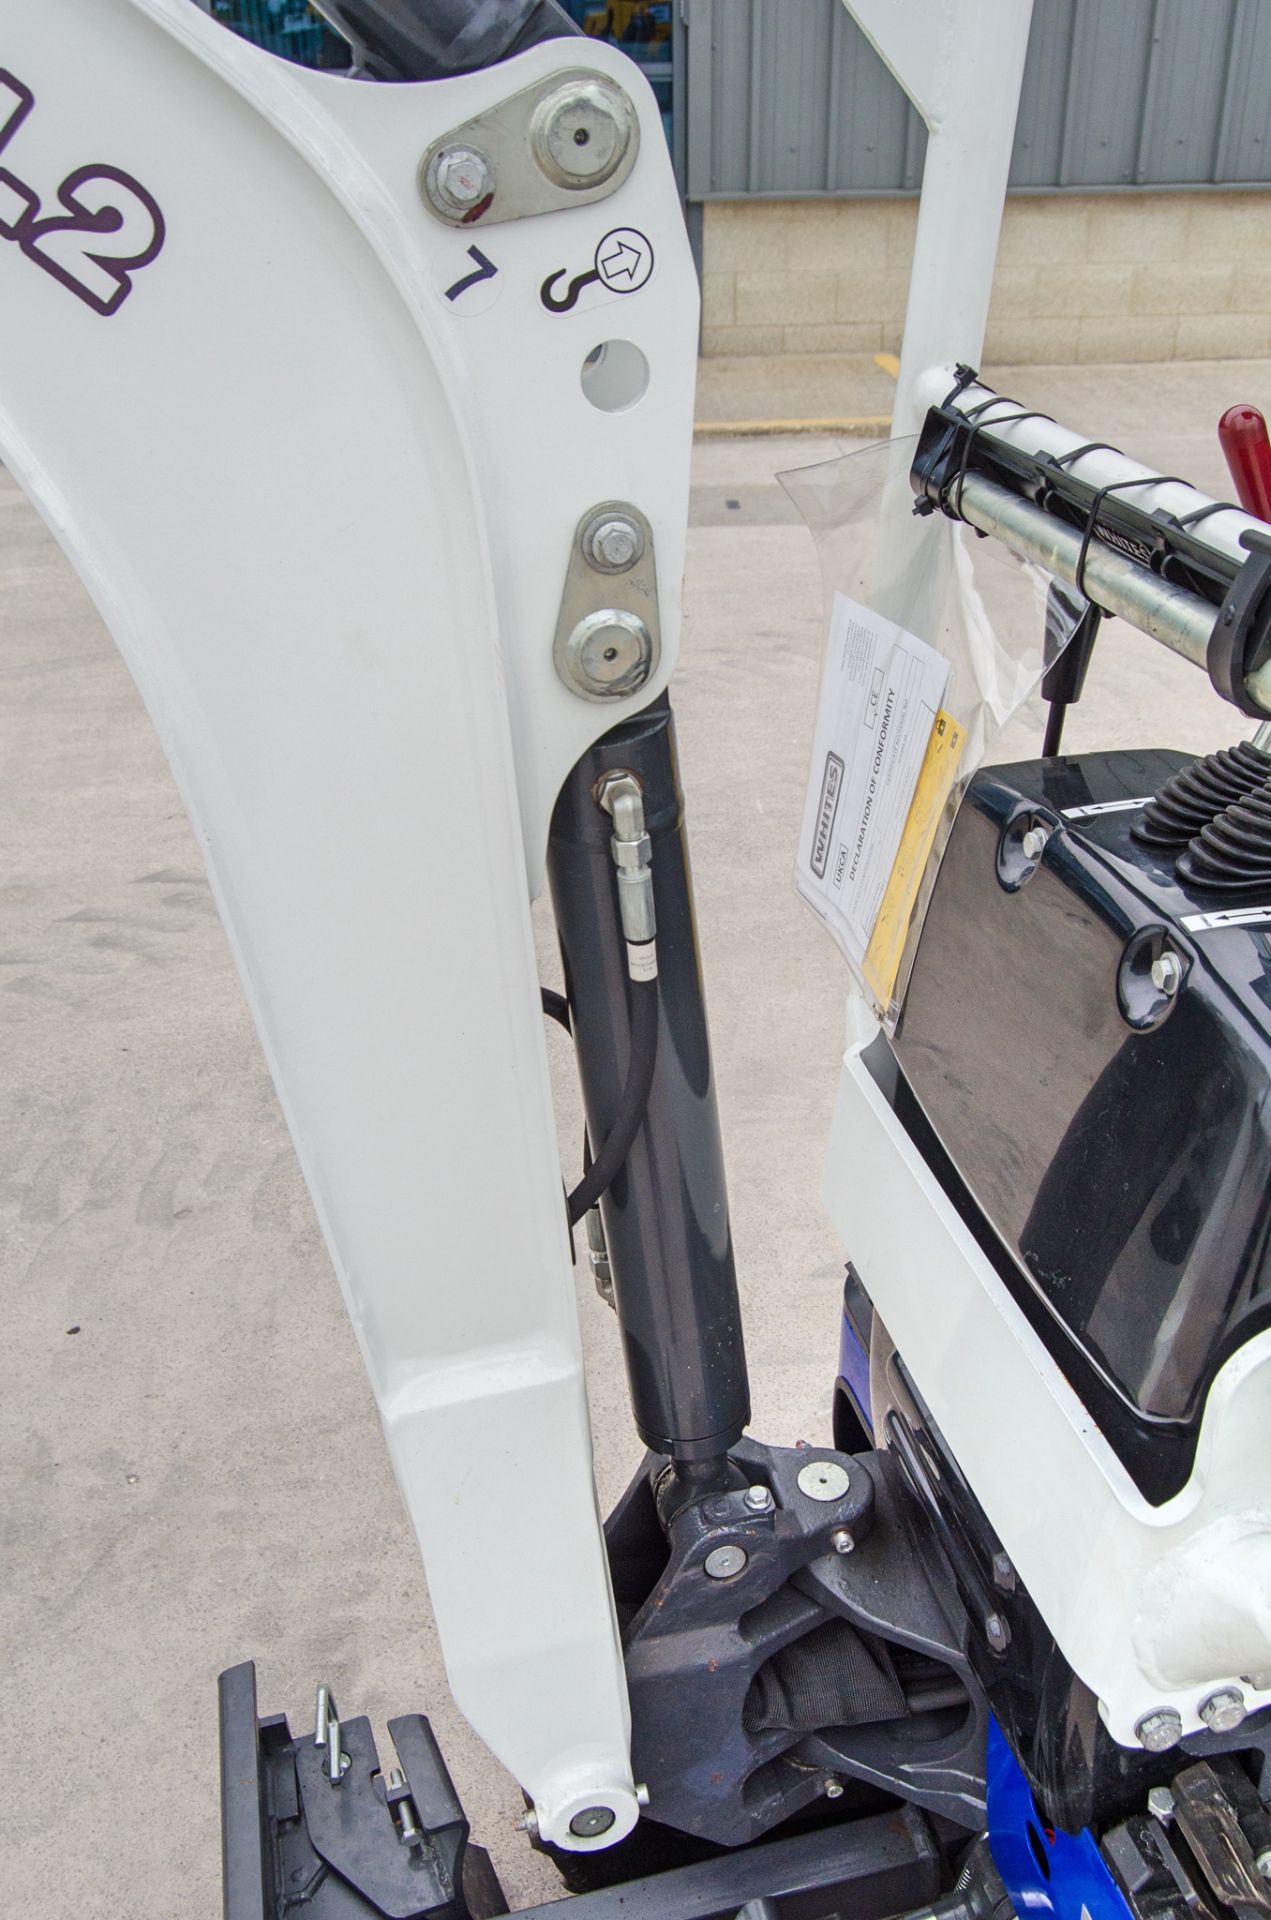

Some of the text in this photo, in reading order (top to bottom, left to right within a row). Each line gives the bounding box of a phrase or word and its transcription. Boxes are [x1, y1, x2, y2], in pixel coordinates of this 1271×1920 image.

[444, 244, 498, 302] 7
[873, 688, 895, 775] CONFORMITY
[814, 764, 839, 864] WHITES
[869, 776, 878, 795] OF
[835, 851, 847, 883] UKCA
[850, 796, 873, 881] DECLARATION
